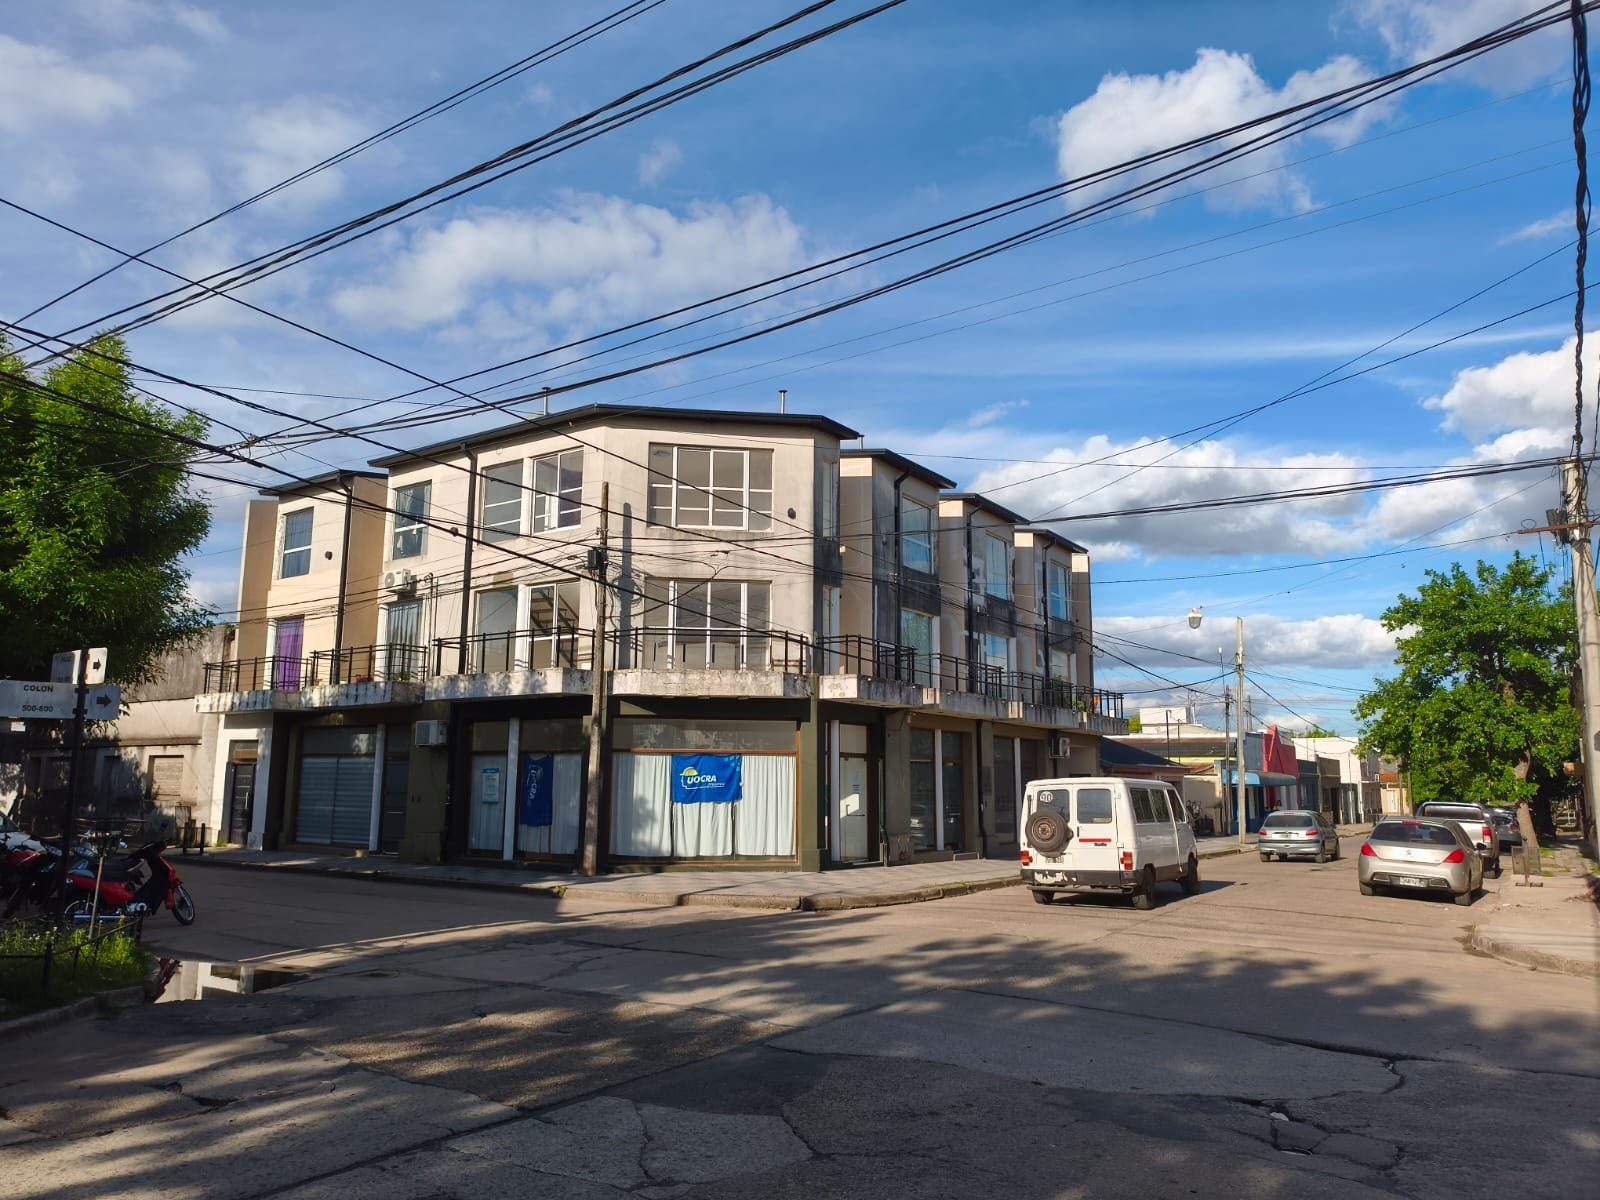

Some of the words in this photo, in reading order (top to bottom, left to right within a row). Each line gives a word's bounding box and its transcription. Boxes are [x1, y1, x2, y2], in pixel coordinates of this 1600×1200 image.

[23, 684, 54, 693] COLON
[22, 704, 54, 712] 500-600
[687, 775, 717, 784] UOCRA
